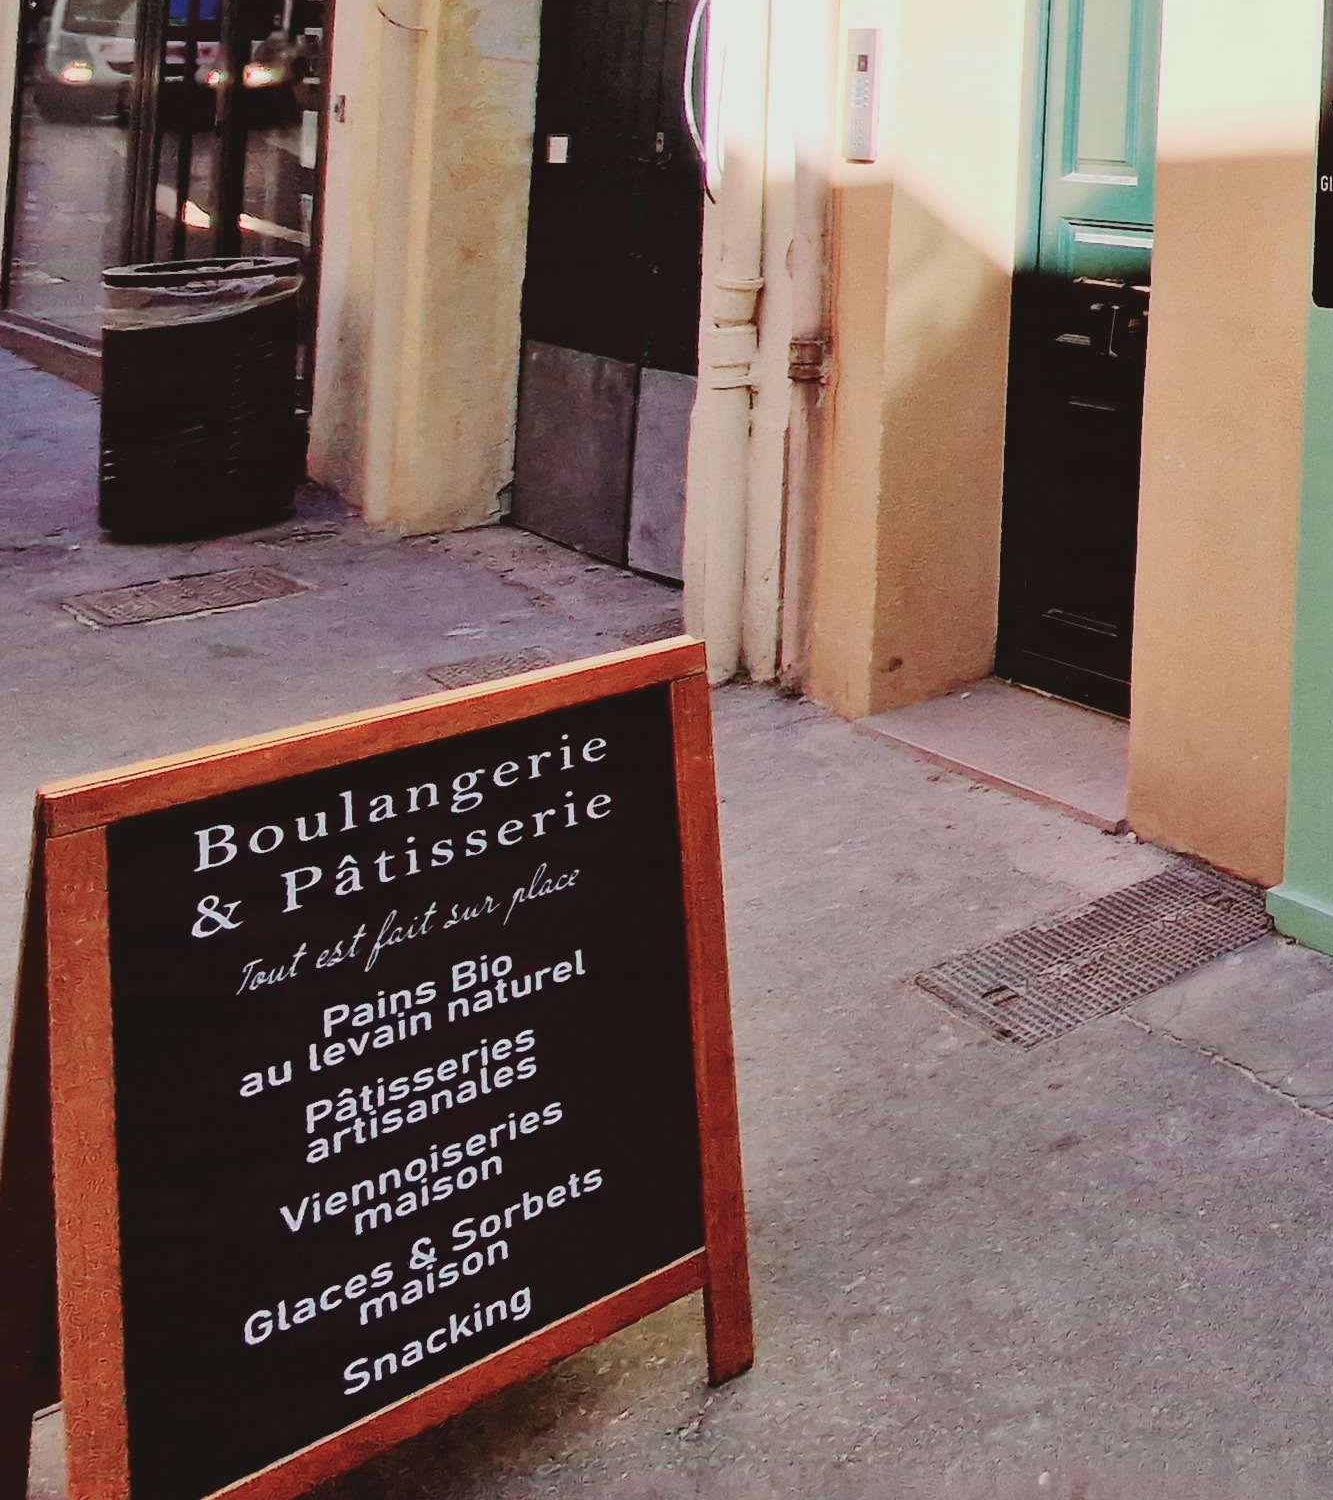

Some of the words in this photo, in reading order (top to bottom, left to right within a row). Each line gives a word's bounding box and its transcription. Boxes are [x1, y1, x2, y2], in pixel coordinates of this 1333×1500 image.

[190, 892, 245, 940] &
[282, 790, 612, 913] Pâtisserie
[194, 733, 609, 874] Boulangerie
[235, 950, 307, 997] Tout
[314, 933, 363, 969] est
[367, 905, 437, 972] fait
[443, 896, 500, 929] sur
[504, 862, 581, 925] place
[238, 1056, 294, 1099] au
[308, 1012, 434, 1073] levain
[446, 950, 586, 1025] naturel
[322, 977, 438, 1039] Pains
[451, 952, 513, 993] Bio
[303, 1028, 536, 1135] Pâtisseries
[304, 1052, 538, 1166] artisanales
[278, 1100, 564, 1235] Viennoiseries
[353, 1153, 504, 1236] maison
[243, 1260, 395, 1346] Glaces
[408, 1234, 438, 1272] &
[450, 1166, 604, 1256] Sorbets
[358, 1238, 510, 1327] maison
[342, 1281, 535, 1398] Snacking
